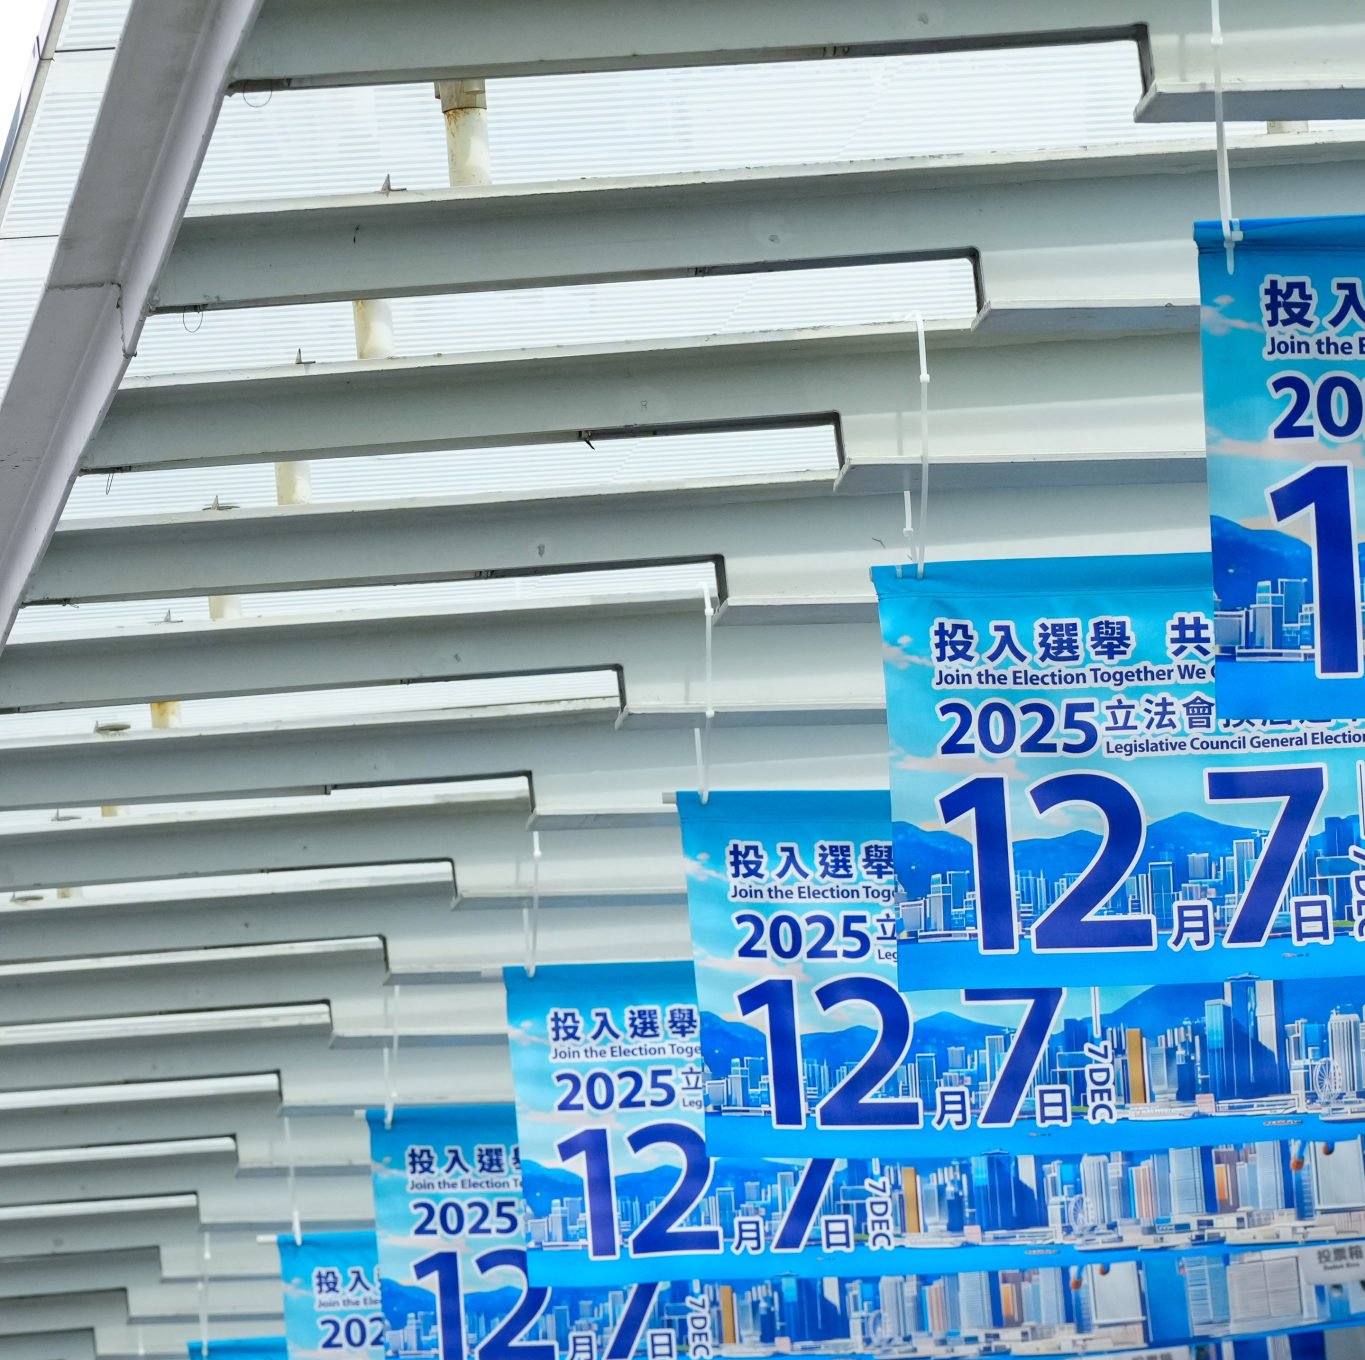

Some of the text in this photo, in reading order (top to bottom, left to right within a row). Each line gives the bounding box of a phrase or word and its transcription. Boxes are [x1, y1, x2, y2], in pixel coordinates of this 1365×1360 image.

[1267, 335, 1311, 356] Join
[1316, 336, 1354, 355] the
[933, 621, 1132, 662] 投入選舉
[936, 665, 1207, 687] Join the Election Together We
[1106, 737, 1188, 755] Legislative
[1190, 735, 1247, 752] Council
[1250, 732, 1309, 749] General
[939, 767, 1330, 951] 12月7日
[731, 884, 860, 900] Join the Election
[551, 1011, 698, 1041] 投入選舉
[552, 1047, 581, 1060] Join
[584, 1045, 608, 1059] the
[610, 1044, 665, 1059] Election
[736, 976, 1069, 1128] 12月7日
[409, 1178, 508, 1191] Join the Election
[557, 1123, 851, 1258] 12月7日
[413, 1201, 518, 1236] 2025
